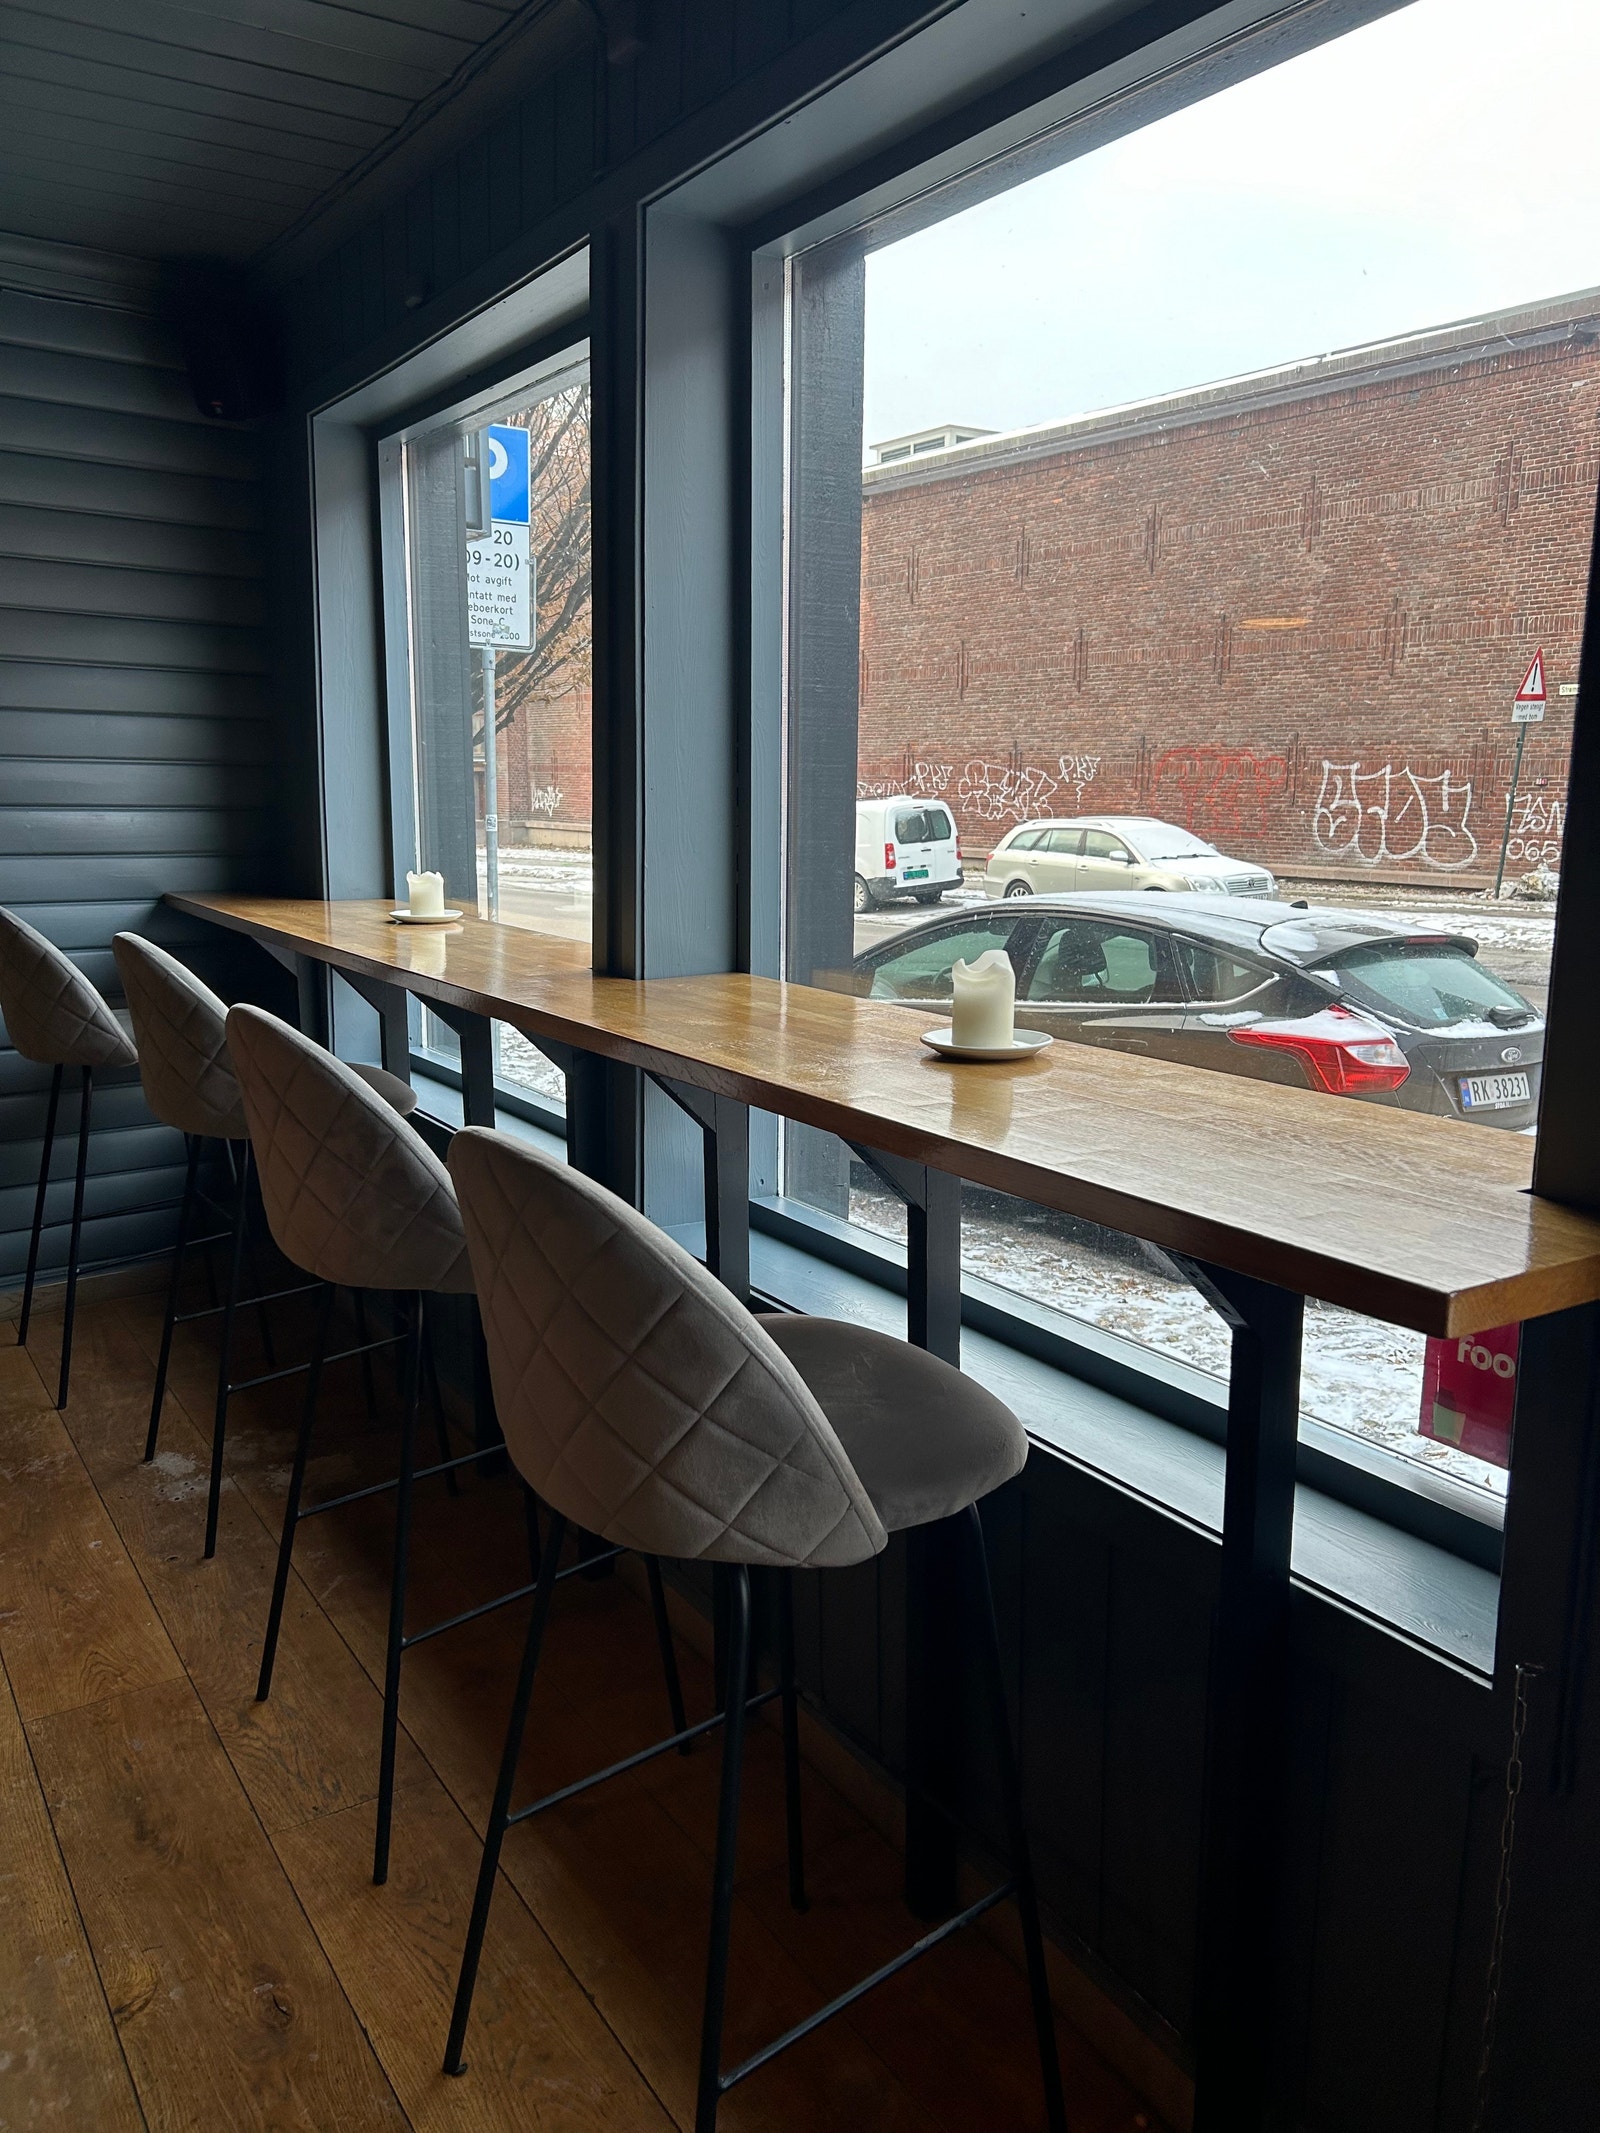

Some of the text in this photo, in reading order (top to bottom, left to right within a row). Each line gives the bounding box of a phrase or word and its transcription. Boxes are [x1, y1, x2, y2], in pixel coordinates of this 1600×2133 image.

[494, 530, 512, 545] 20
[485, 576, 512, 587] avgift
[469, 591, 516, 603] ntatt med
[468, 602, 513, 615] eboerkort
[470, 614, 493, 625] Sone
[1471, 1080, 1490, 1102] RK
[1494, 1076, 1527, 1099] 38231
